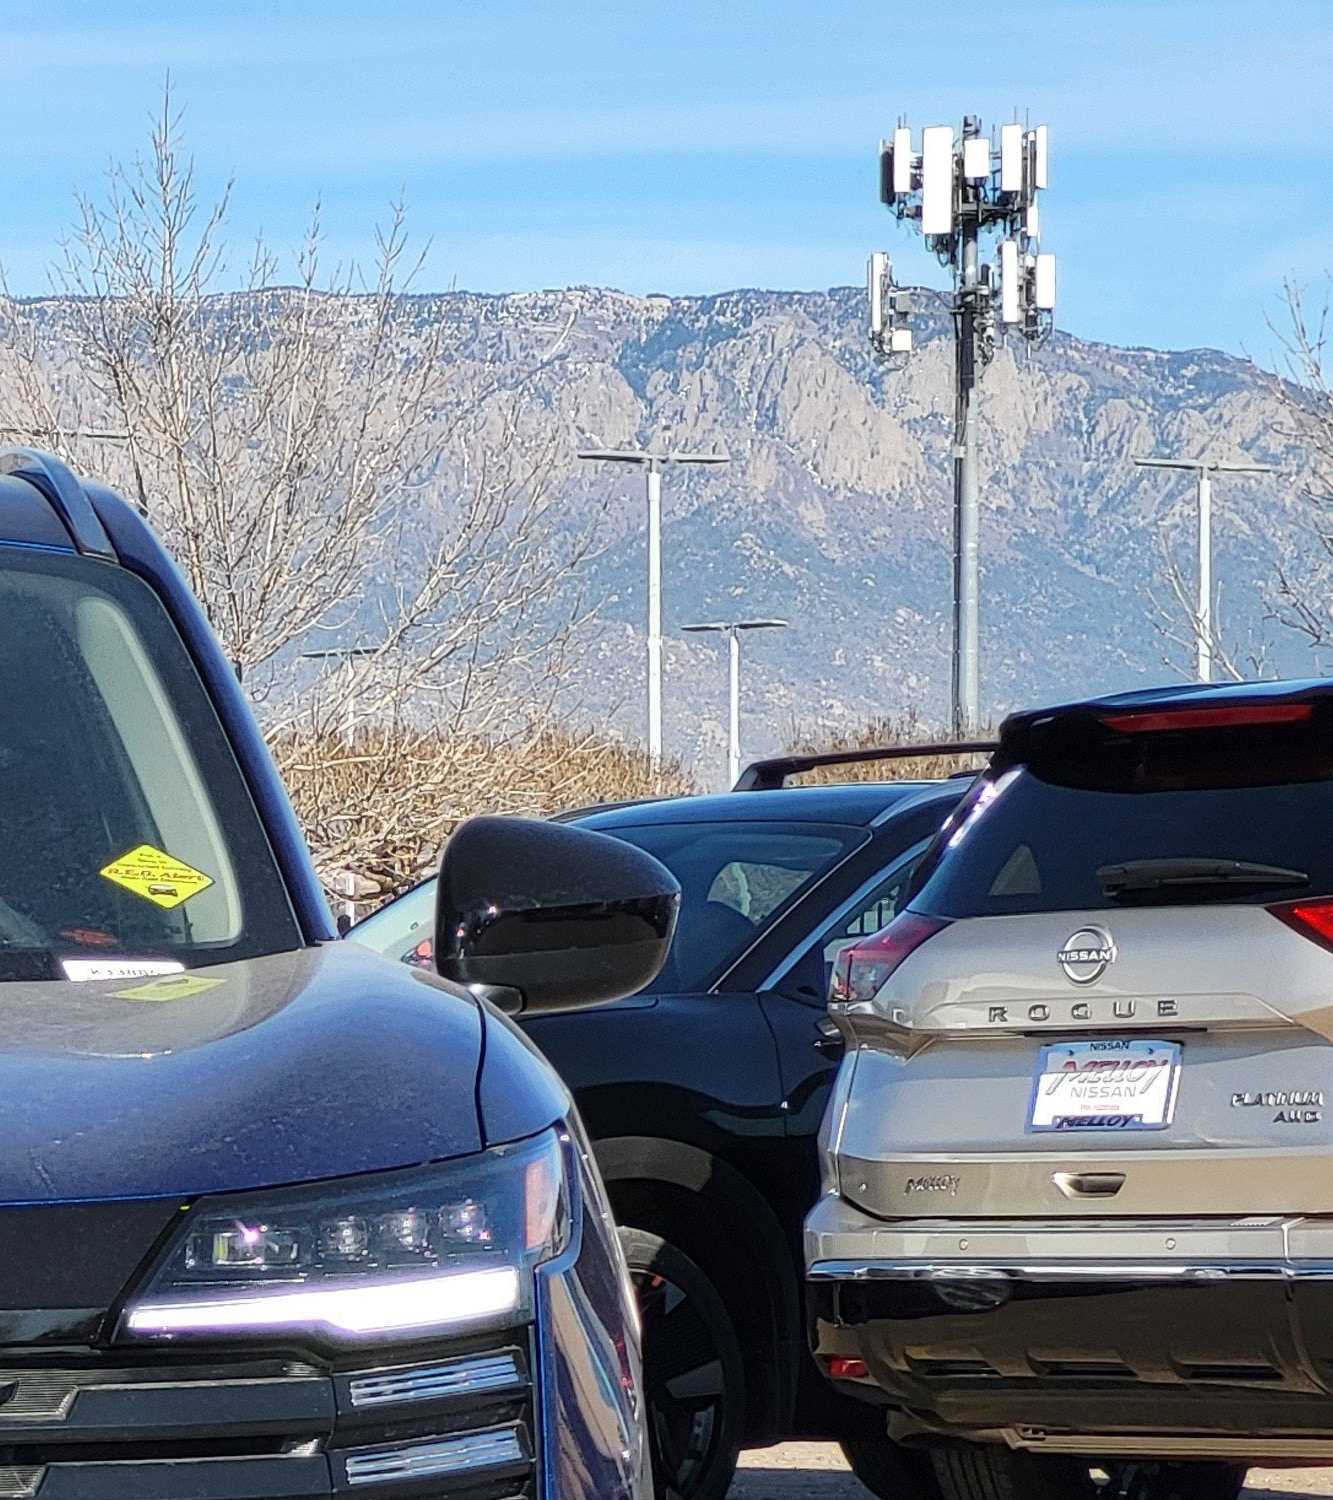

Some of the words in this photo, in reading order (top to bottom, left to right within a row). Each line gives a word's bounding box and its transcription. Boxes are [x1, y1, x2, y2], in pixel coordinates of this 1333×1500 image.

[1057, 950, 1111, 962] NISSAN
[988, 1000, 1179, 1023] ROGUE
[1070, 1086, 1137, 1098] NISSAN
